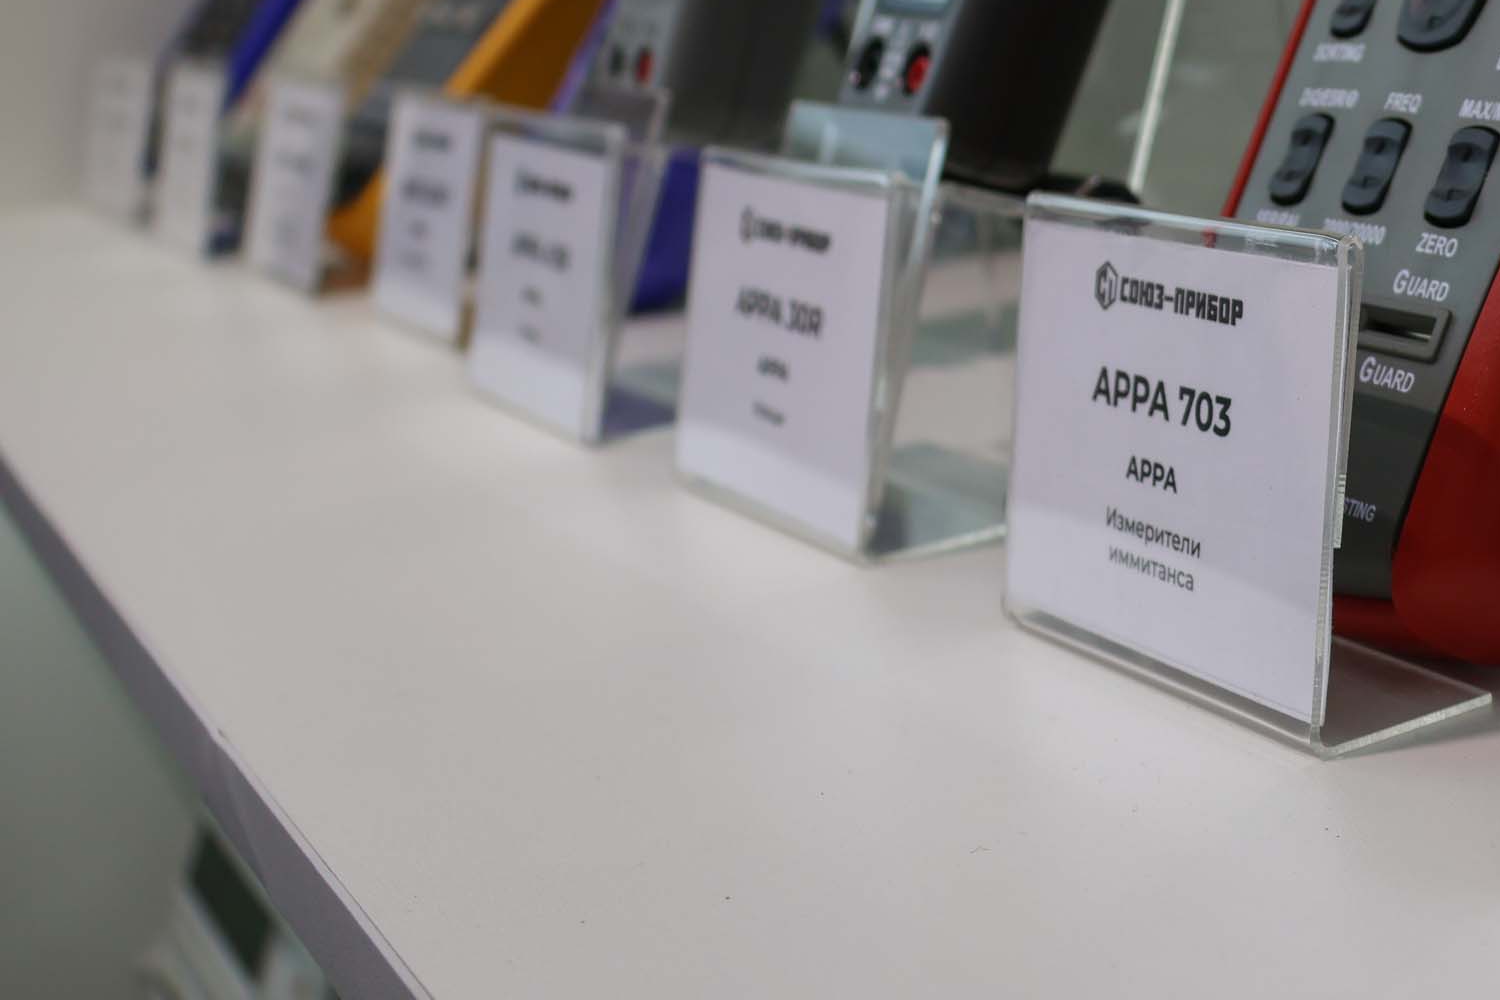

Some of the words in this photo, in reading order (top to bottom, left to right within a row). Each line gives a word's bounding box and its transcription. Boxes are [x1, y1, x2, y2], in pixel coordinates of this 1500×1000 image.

[1383, 92, 1422, 114] FREQ
[1415, 231, 1459, 258] ZERO
[1120, 278, 1244, 326] СОЮЗ-ПРИБОР
[1092, 366, 1170, 422] APPA
[1178, 386, 1232, 437] 703
[1125, 455, 1178, 494] APPA
[1106, 505, 1201, 560] Измерители
[1108, 545, 1195, 593] иммитанса
